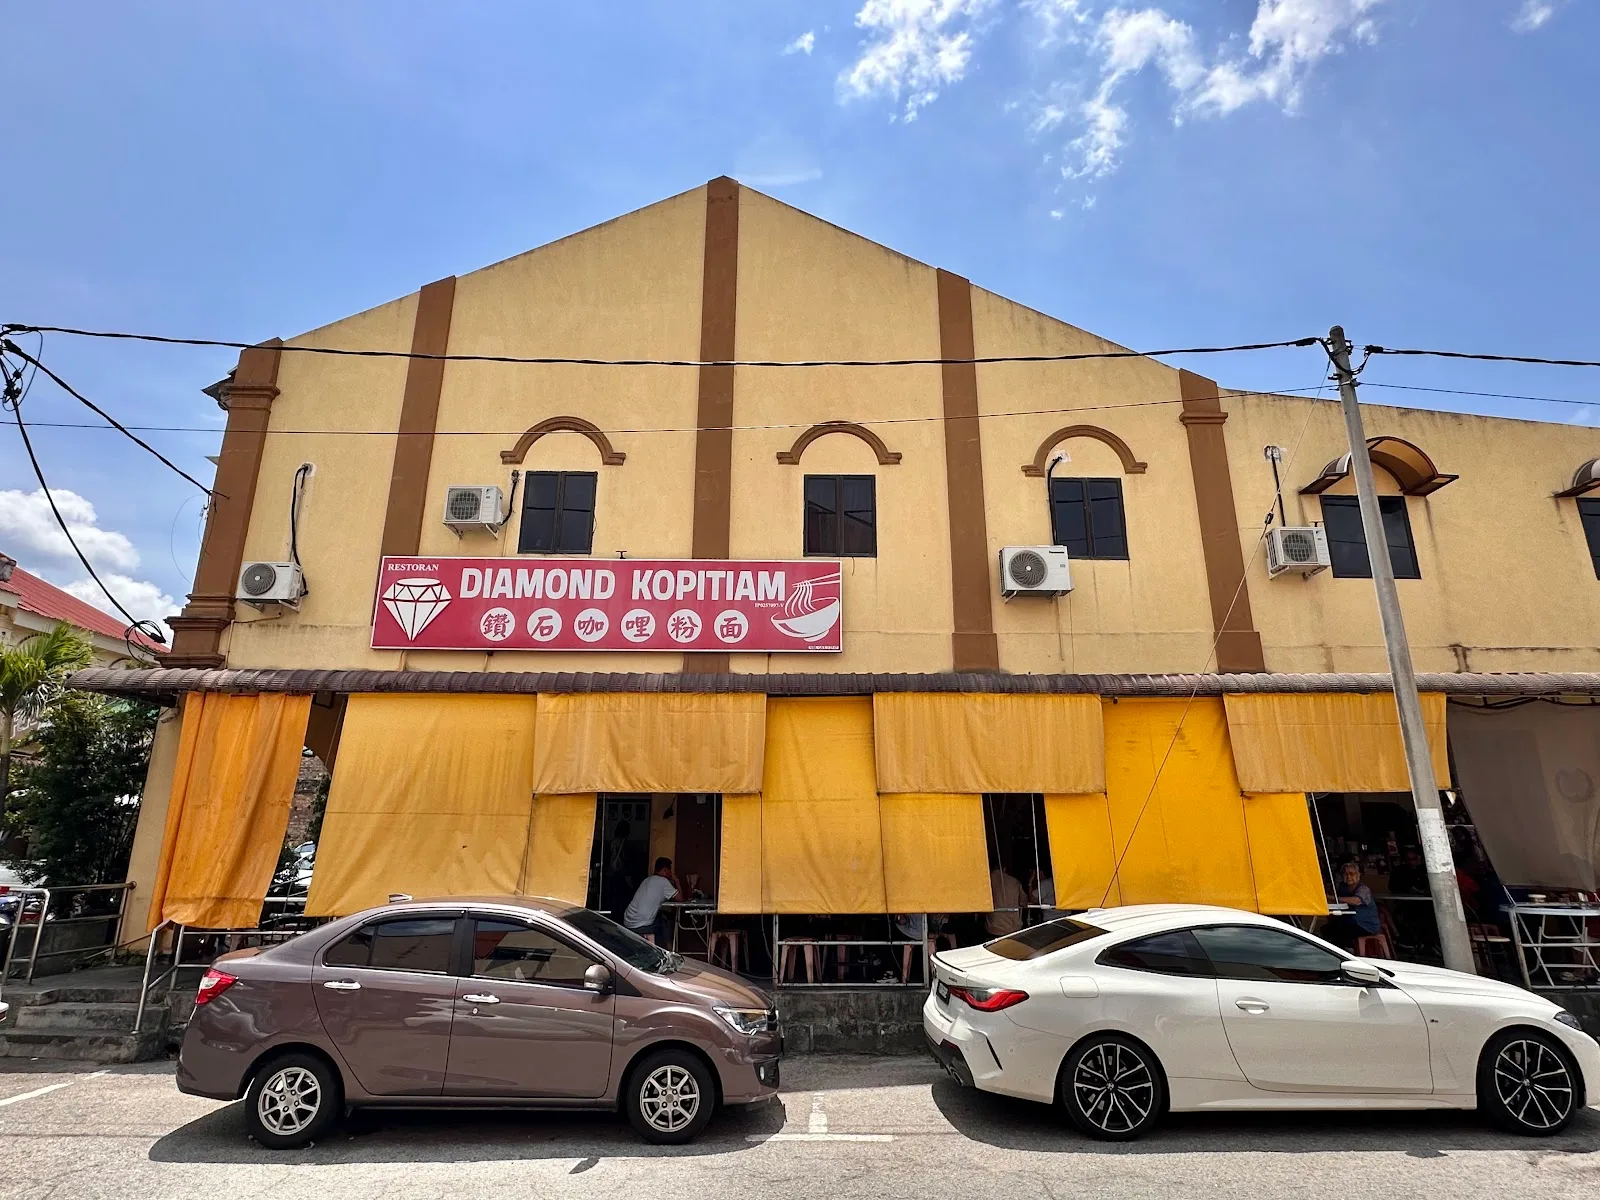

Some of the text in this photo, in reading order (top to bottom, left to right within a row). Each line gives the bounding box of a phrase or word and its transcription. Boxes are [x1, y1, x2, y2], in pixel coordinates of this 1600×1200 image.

[387, 563, 439, 571] RESTORAN
[459, 568, 786, 601] DIAMOND KOPITIAM
[482, 612, 742, 639] 鑽石咖哩粉面
